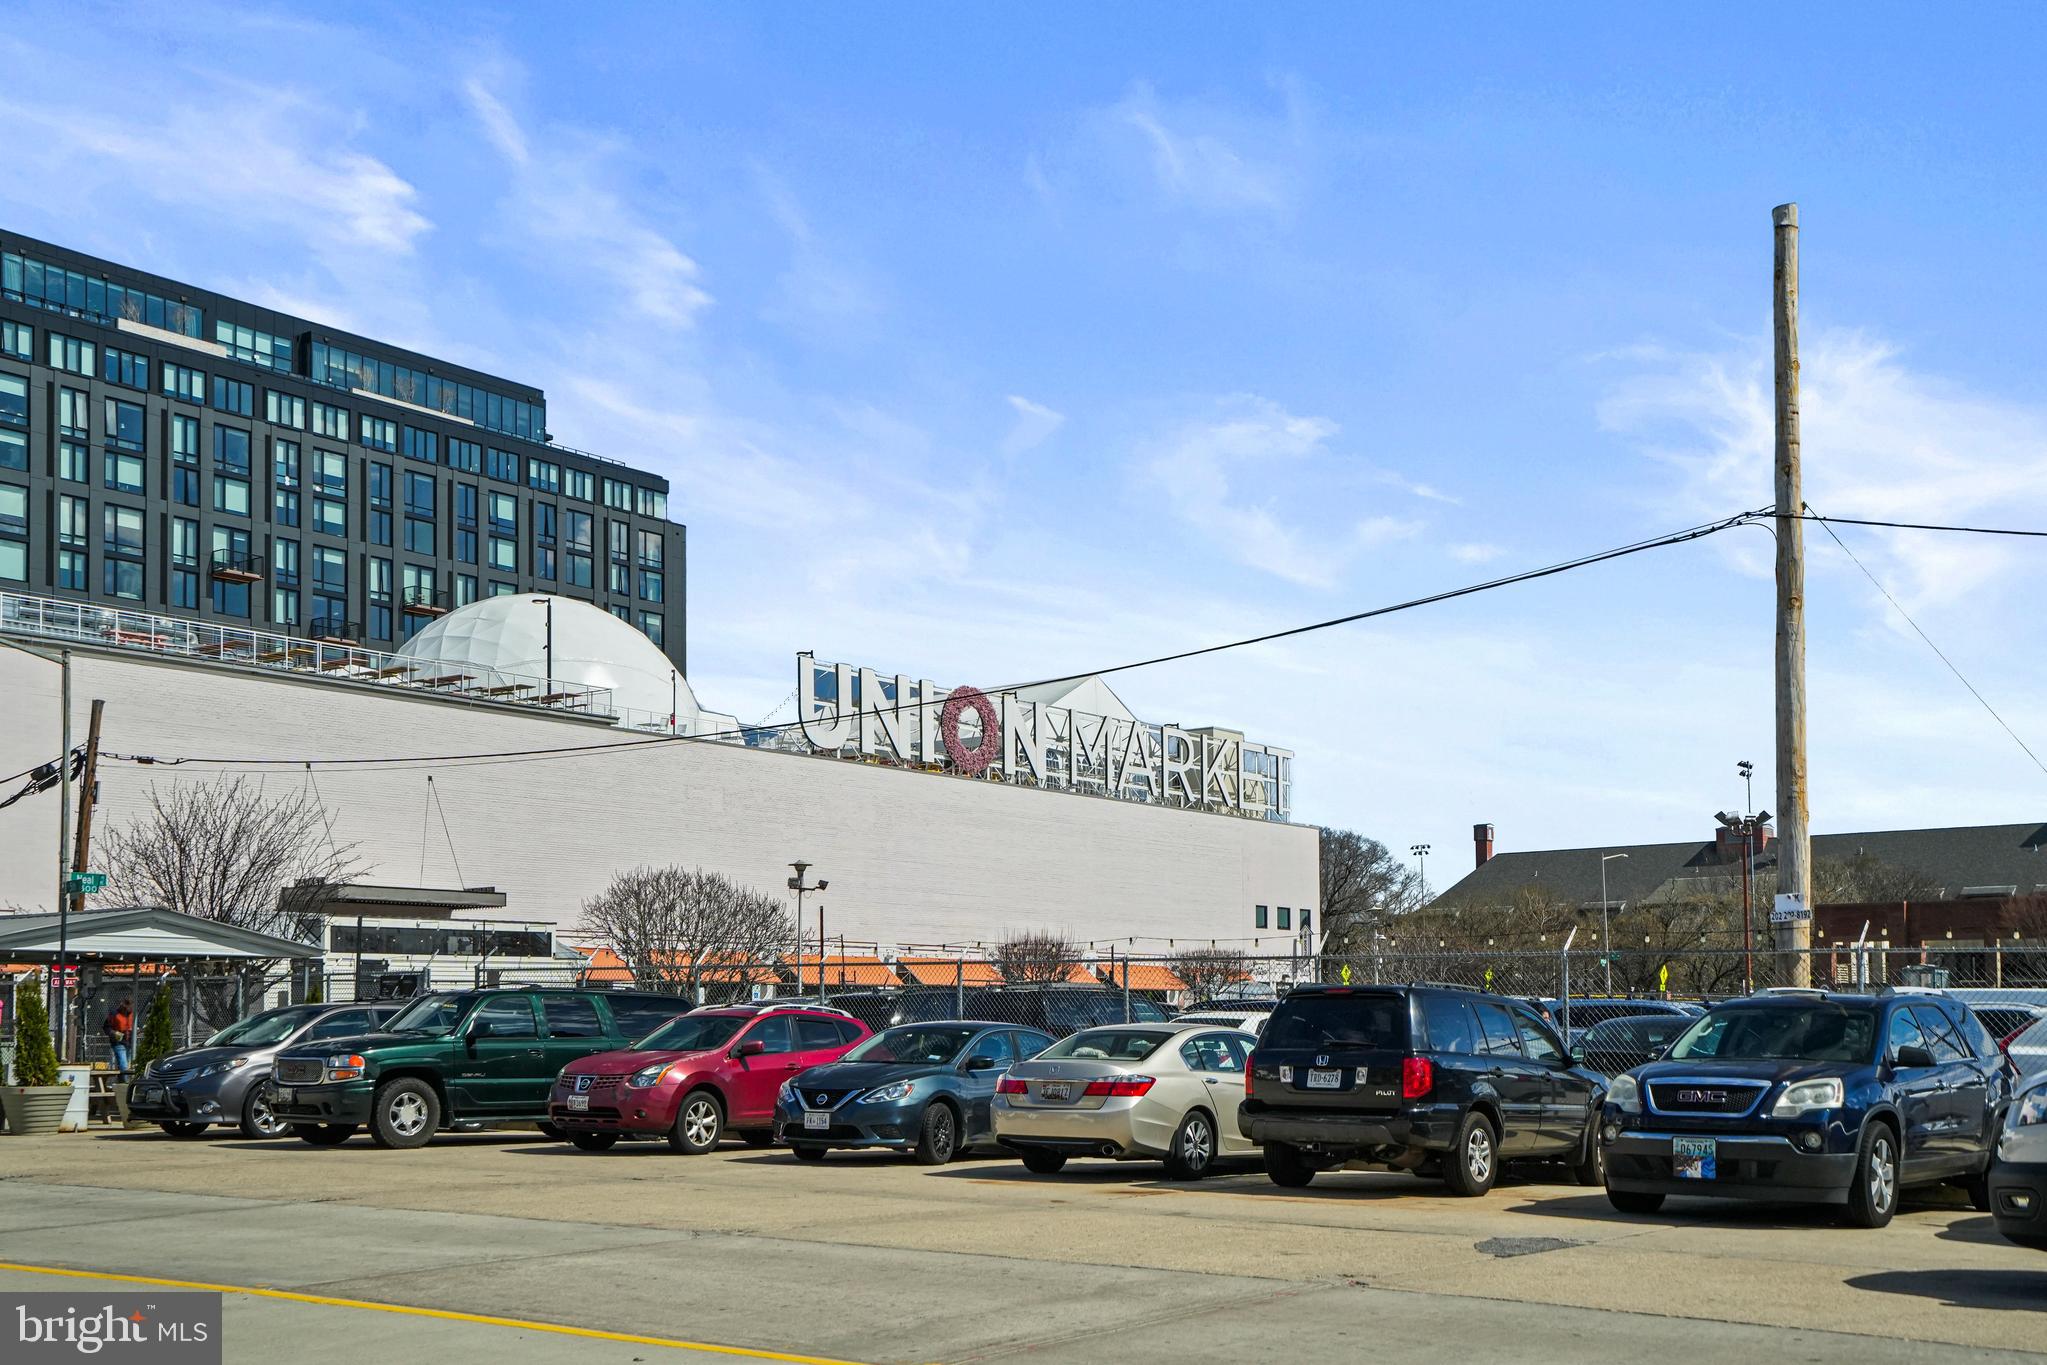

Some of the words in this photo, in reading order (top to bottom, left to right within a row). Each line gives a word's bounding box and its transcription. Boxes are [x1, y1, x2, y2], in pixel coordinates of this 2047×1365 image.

[798, 656, 1047, 779] UNION
[1069, 708, 1294, 815] MARKET
[77, 874, 95, 885] Neal
[1677, 1090, 1727, 1103] GMC
